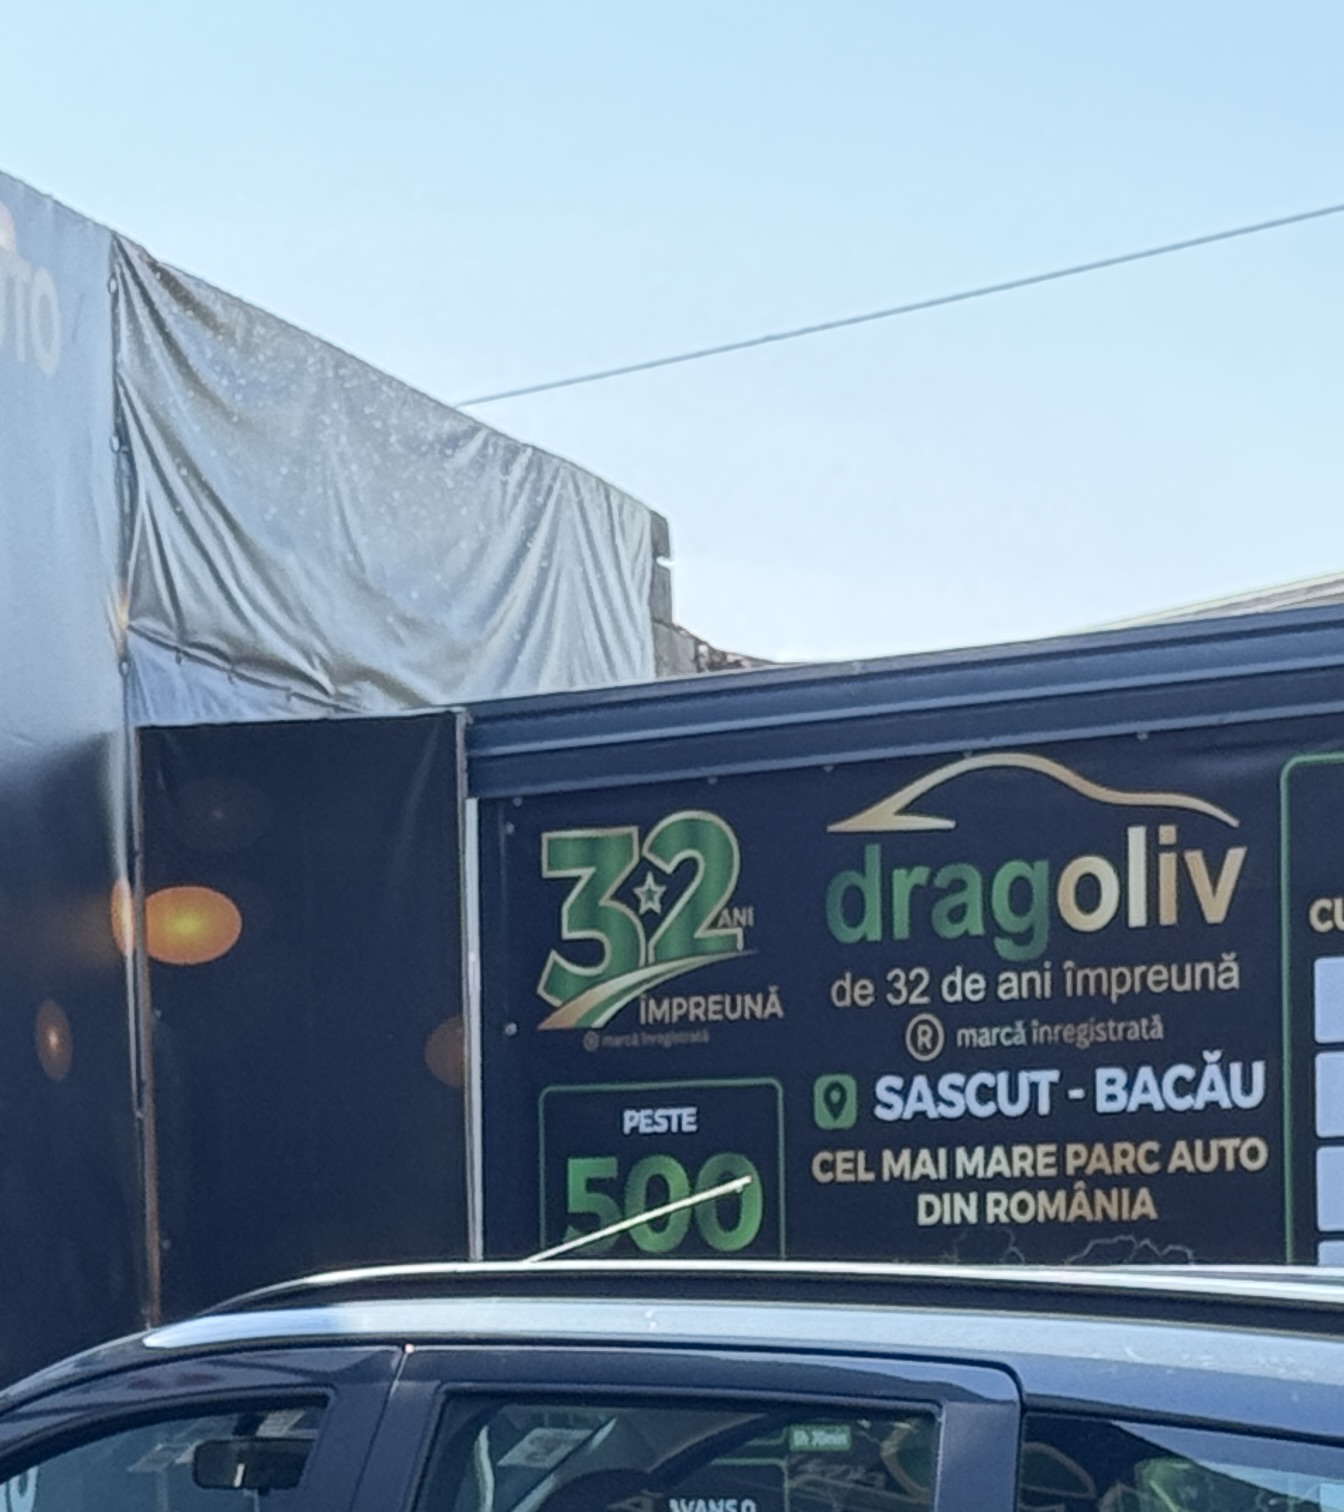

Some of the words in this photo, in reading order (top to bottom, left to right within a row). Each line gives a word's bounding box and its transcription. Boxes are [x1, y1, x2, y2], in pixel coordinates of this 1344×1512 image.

[537, 809, 741, 1008] 32
[826, 825, 1247, 961] dragoliv
[639, 985, 784, 1025] ÎMPREUNĂ
[832, 973, 874, 1007] de
[886, 968, 930, 1004] 32
[941, 966, 986, 1002] de
[998, 963, 1052, 999] ani
[1064, 953, 1240, 1004] împreună
[957, 1021, 1027, 1048] marcă
[1033, 1014, 1164, 1050] înregistrată
[874, 1069, 1059, 1122] SASCUT
[1095, 1050, 1266, 1114] BACĂU
[623, 1108, 698, 1134] PESTE
[812, 1150, 875, 1183] CEL
[882, 1148, 946, 1181] MAI
[955, 1144, 1058, 1178] MARE
[1065, 1141, 1160, 1175] PARC
[1168, 1136, 1269, 1173] AUTO
[564, 1152, 764, 1253] 500
[917, 1193, 977, 1226] DIN
[986, 1181, 1158, 1224] ROMÂNIA
